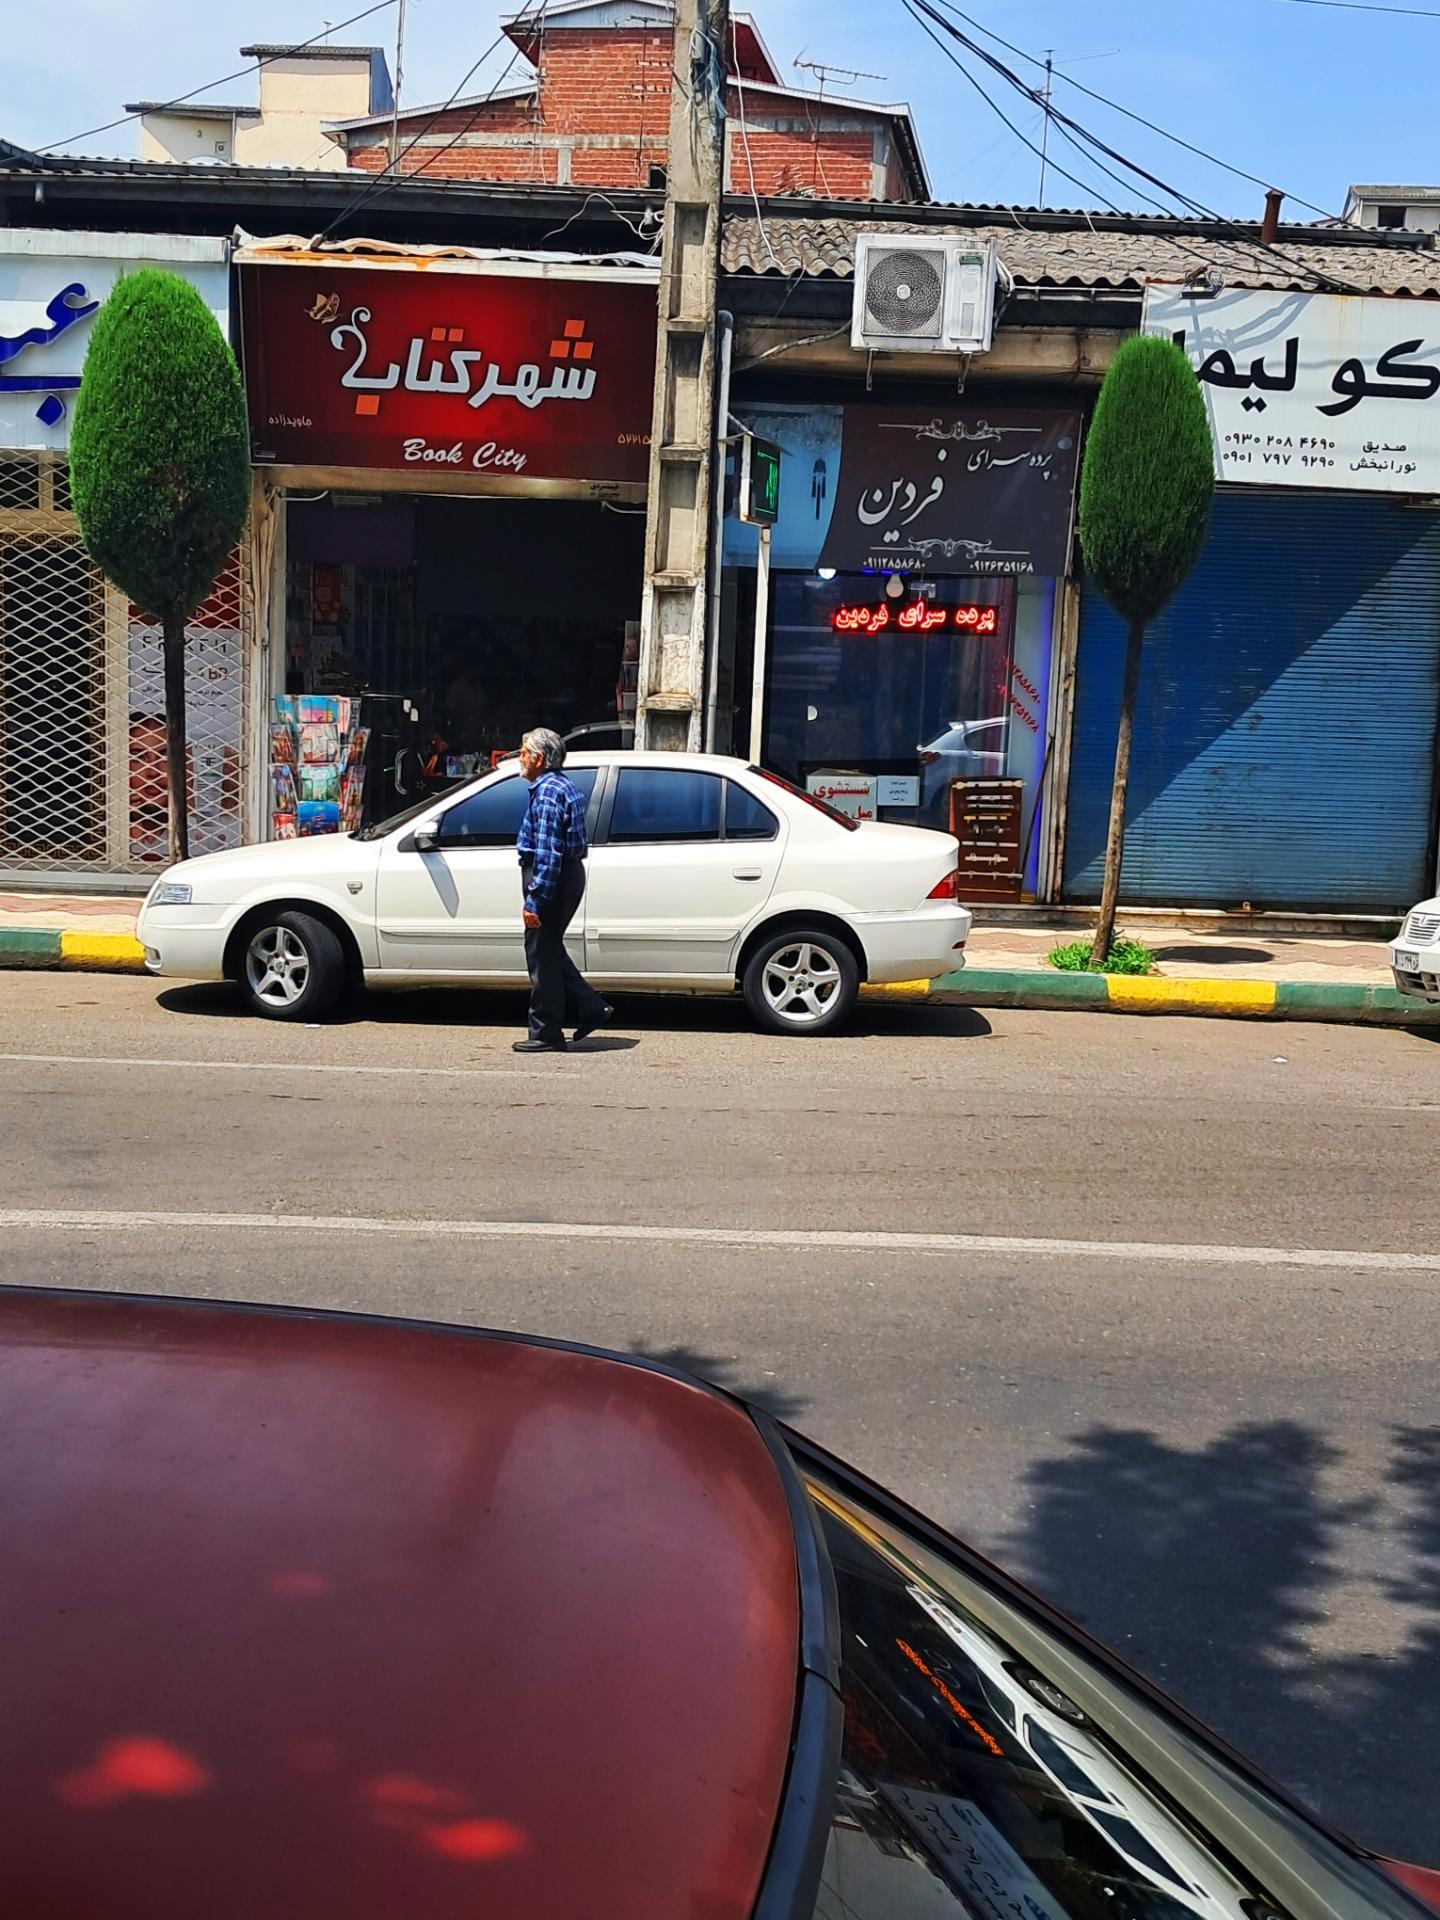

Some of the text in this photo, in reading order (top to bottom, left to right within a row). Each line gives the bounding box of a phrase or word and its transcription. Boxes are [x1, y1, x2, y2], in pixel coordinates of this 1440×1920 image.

[402, 438, 528, 472] Book City
[1362, 441, 1407, 454] صدیق
[967, 449, 1053, 480] پرده سرای
[858, 449, 947, 542] فردین
[836, 601, 995, 631] پرده سرای فردین
